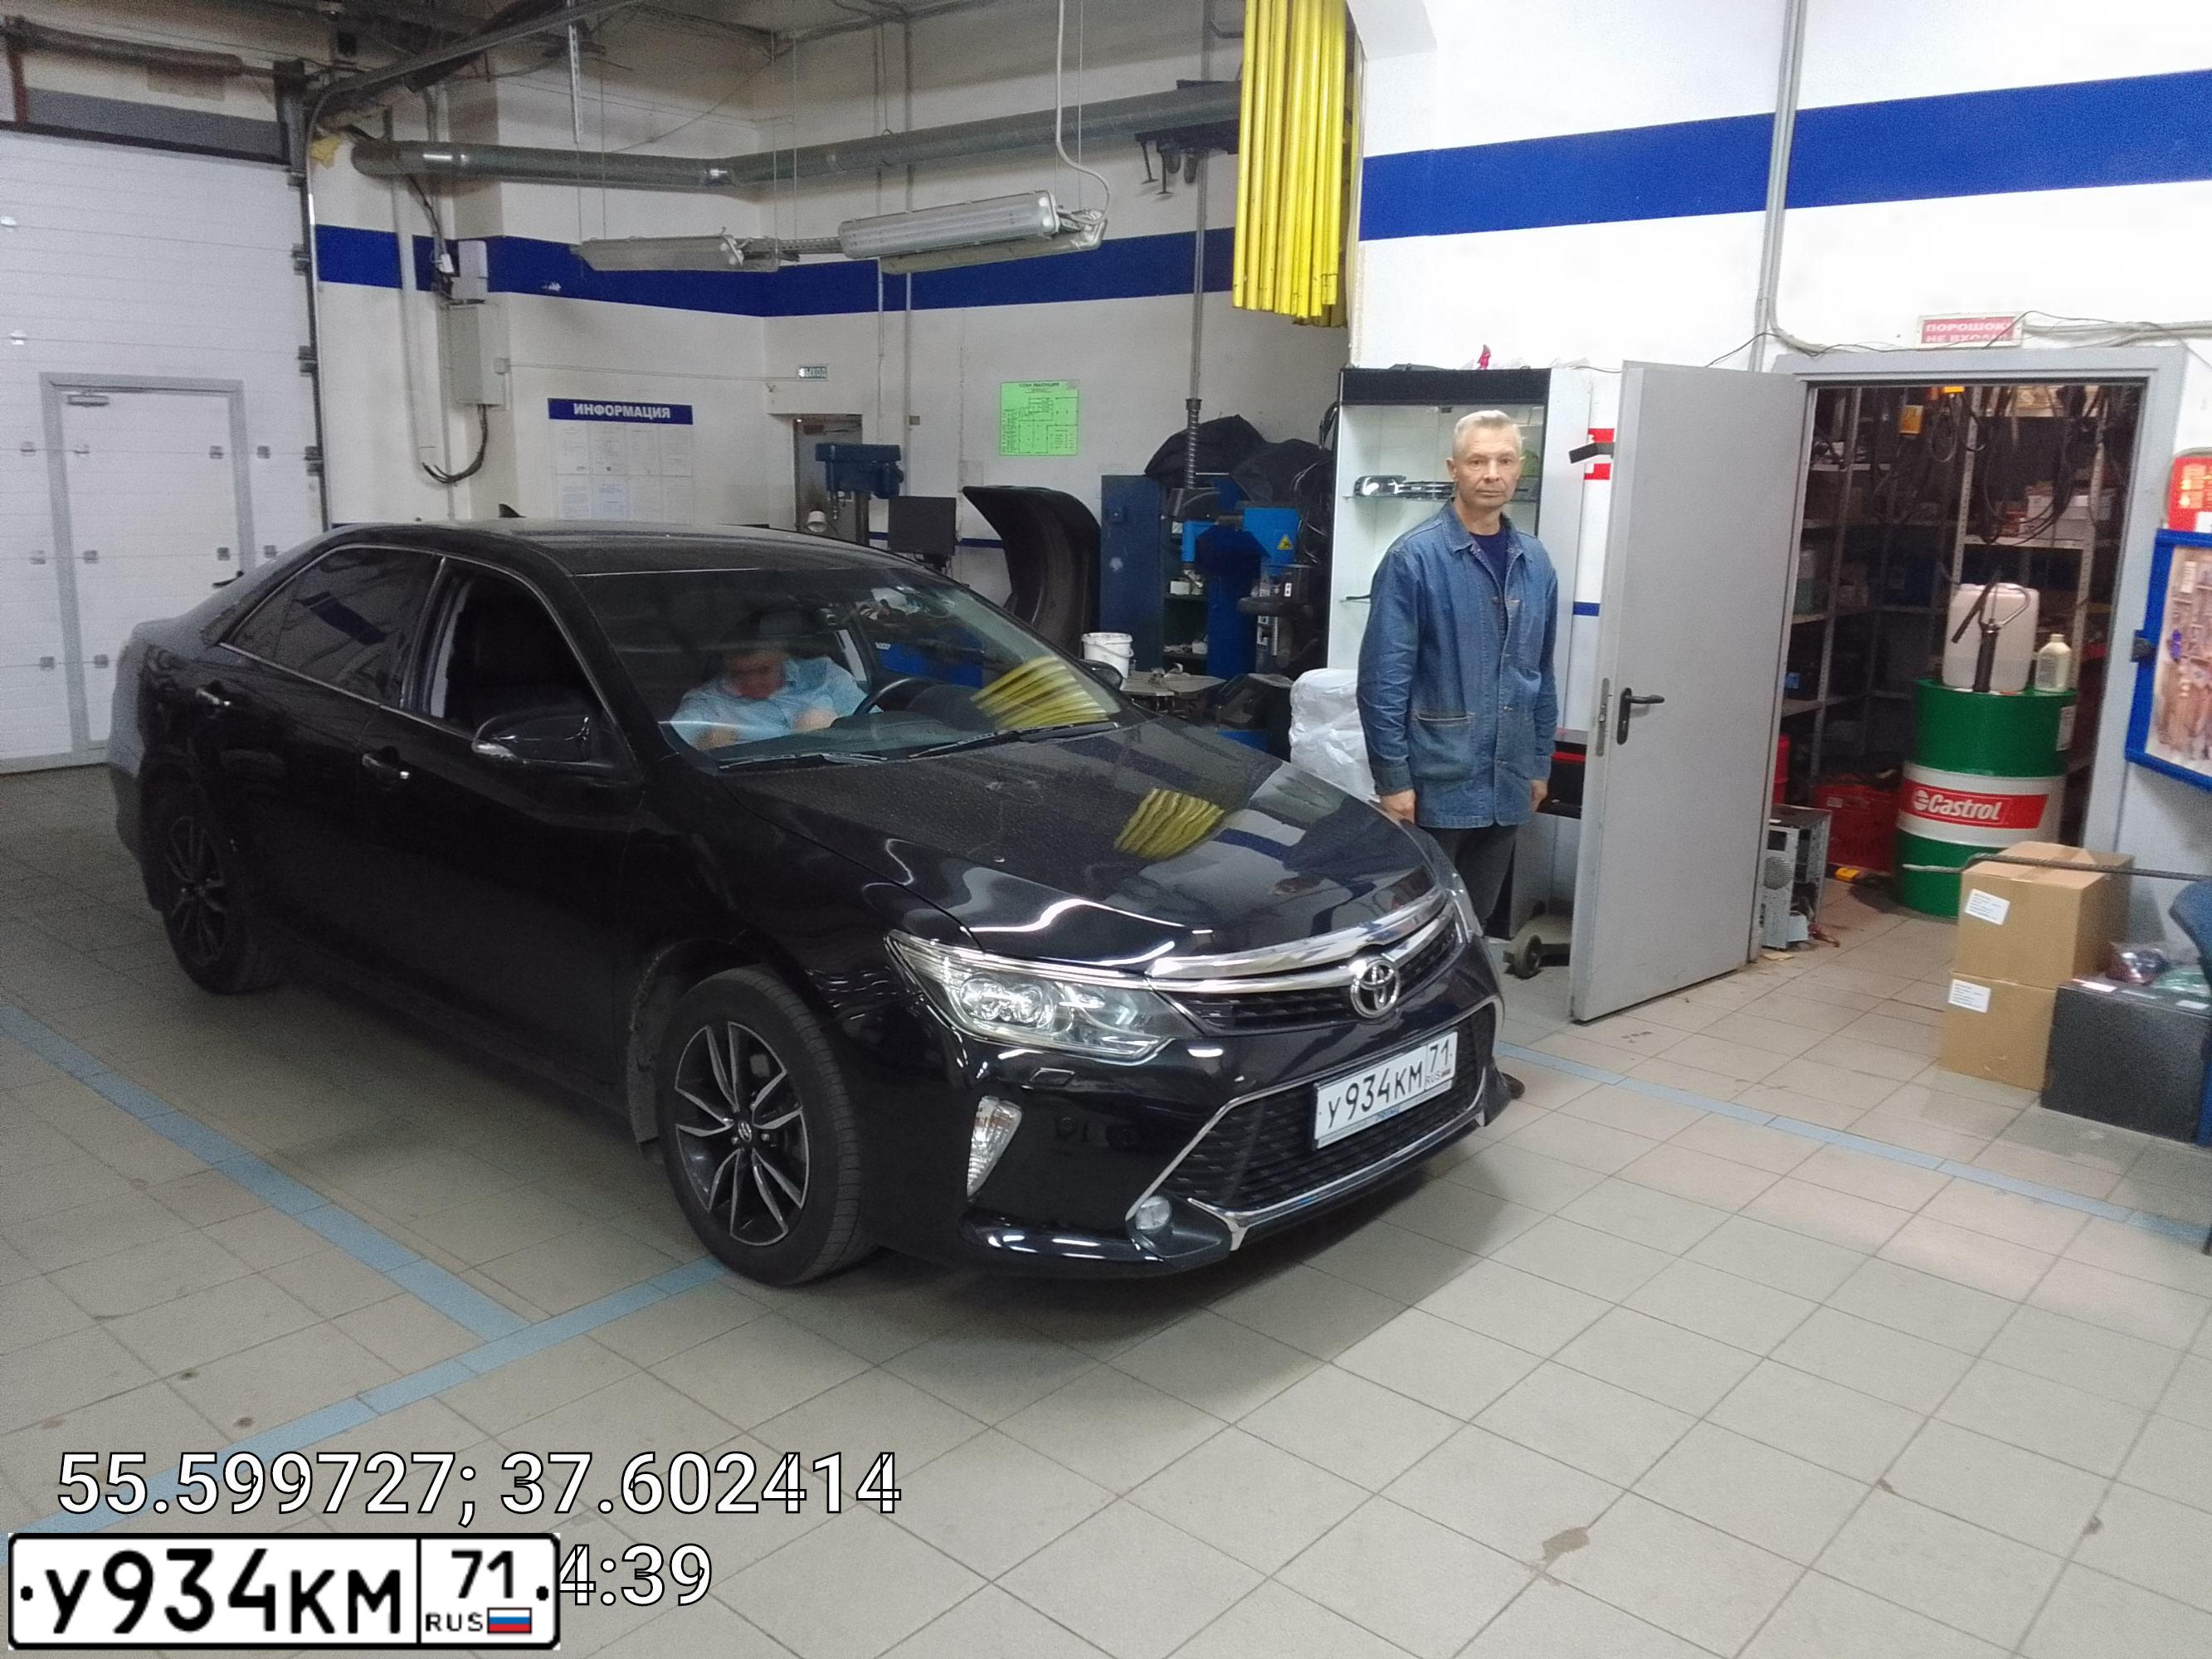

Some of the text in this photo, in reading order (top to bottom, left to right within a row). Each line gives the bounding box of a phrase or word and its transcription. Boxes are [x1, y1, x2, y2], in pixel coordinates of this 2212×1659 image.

[573, 403, 670, 420] ИНФОРМАЦИЯ
[1928, 794, 2003, 820] Castrol
[1328, 1061, 1422, 1128] У934КМ
[1430, 1039, 1449, 1073] 71
